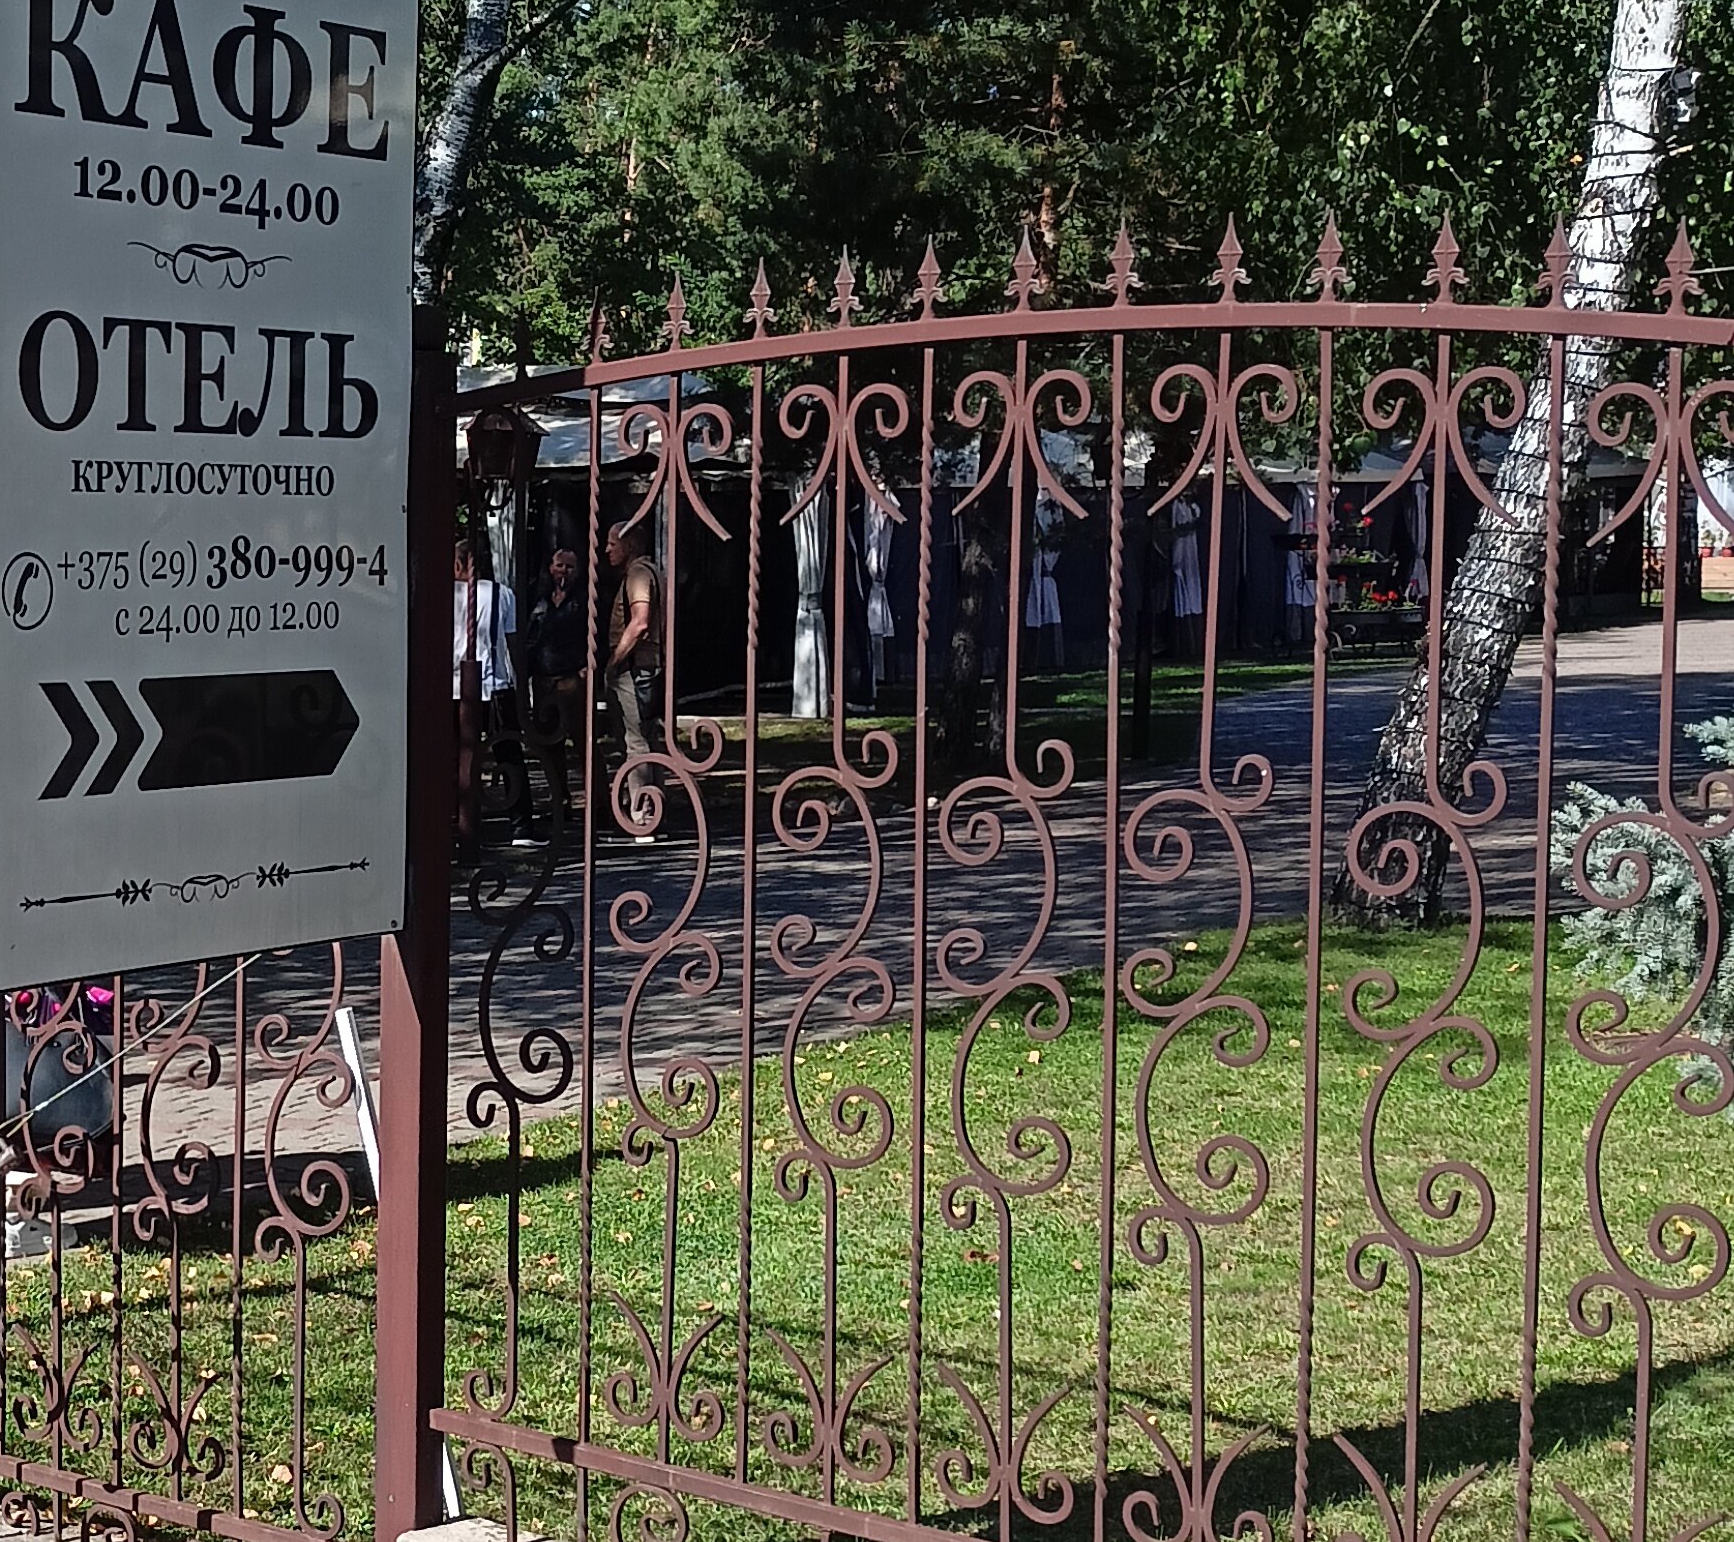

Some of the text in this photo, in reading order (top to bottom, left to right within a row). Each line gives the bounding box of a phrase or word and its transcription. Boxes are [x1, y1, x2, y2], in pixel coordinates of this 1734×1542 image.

[73, 156, 340, 230] 12.00-24.00
[19, 309, 379, 439] ОТЕЛЬ
[70, 459, 335, 496] КРУГЛОСУТОЧНО
[57, 535, 388, 590] +375 (29) 380-999-4
[138, 603, 221, 643] 24.00
[268, 600, 341, 632] 12.00
